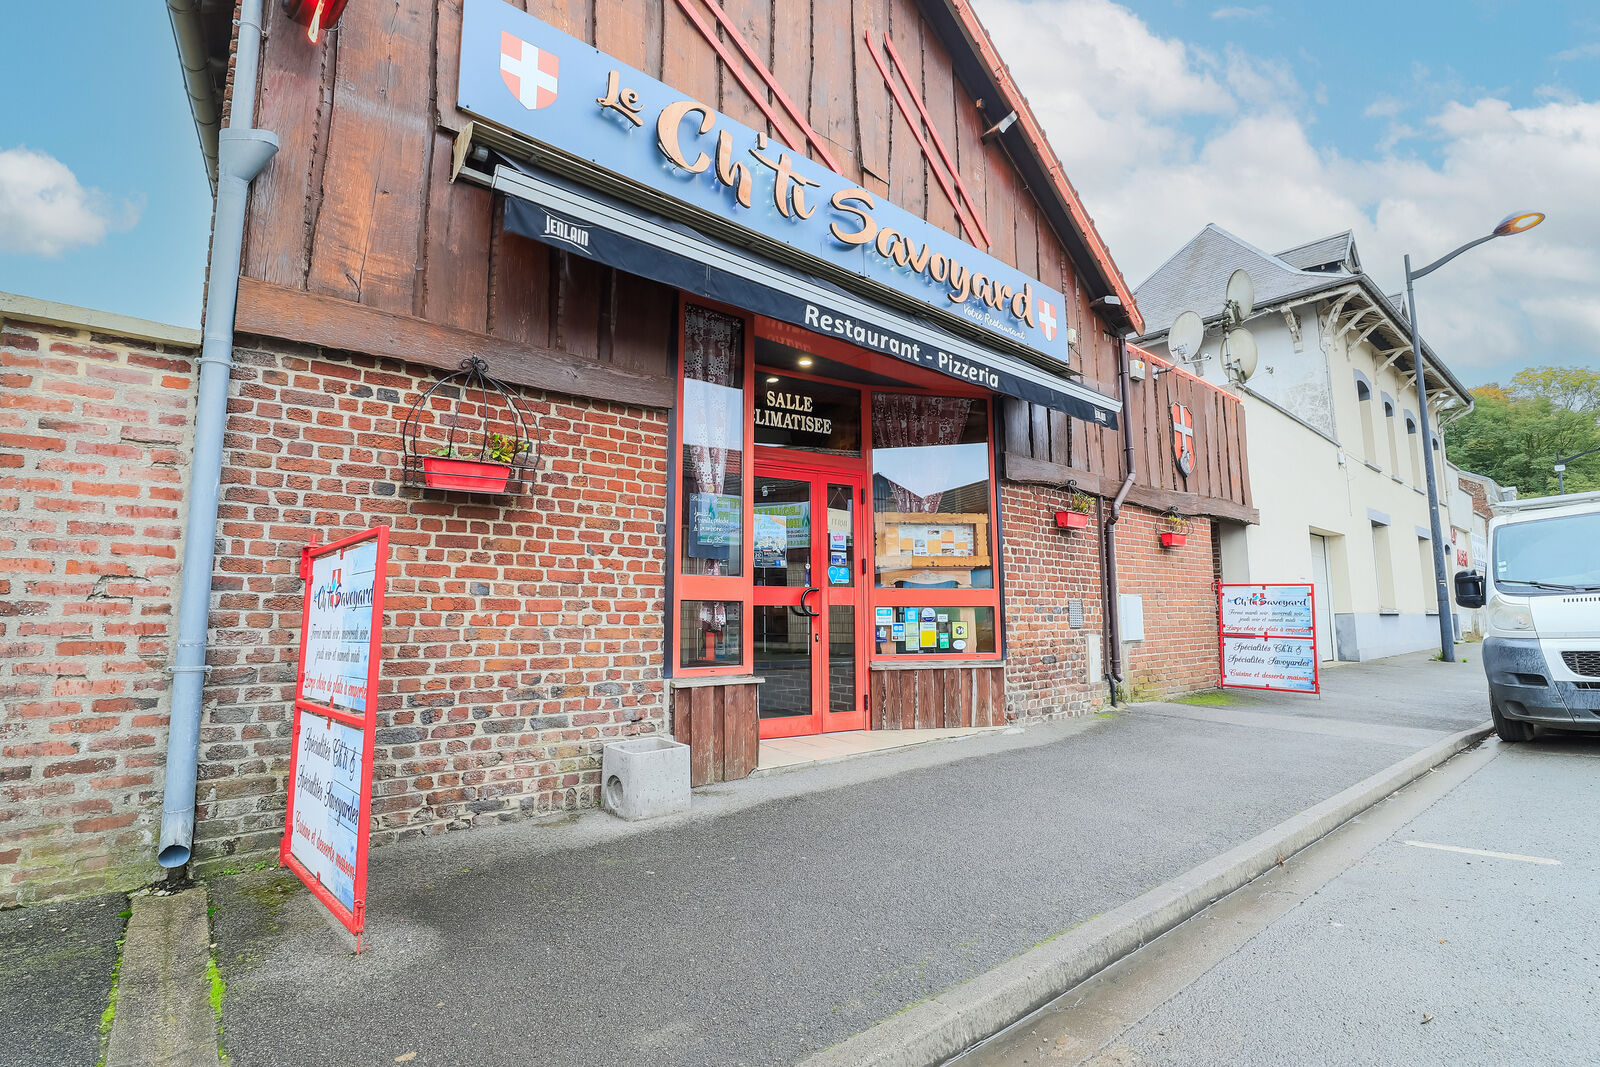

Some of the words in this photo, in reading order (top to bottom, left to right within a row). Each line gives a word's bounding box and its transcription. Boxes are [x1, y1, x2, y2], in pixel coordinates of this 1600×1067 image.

[596, 70, 645, 128] Le
[656, 101, 821, 220] Ch'ti
[830, 188, 1035, 328] Savoyard
[963, 304, 984, 323] Votre
[984, 312, 1027, 340] Restaurant
[804, 304, 921, 362] Restaurant
[938, 351, 999, 388] Pizzeria
[766, 390, 813, 413] SALLE
[335, 580, 375, 611] Savoyard
[1259, 596, 1306, 608] Savoyard
[1228, 654, 1265, 666] Spécialités
[1267, 656, 1310, 669] Savoyardes
[1233, 642, 1271, 653] Spécialités
[1229, 669, 1252, 678] Cuisine
[1262, 671, 1285, 679] desserts
[324, 781, 359, 826] Savoyardes
